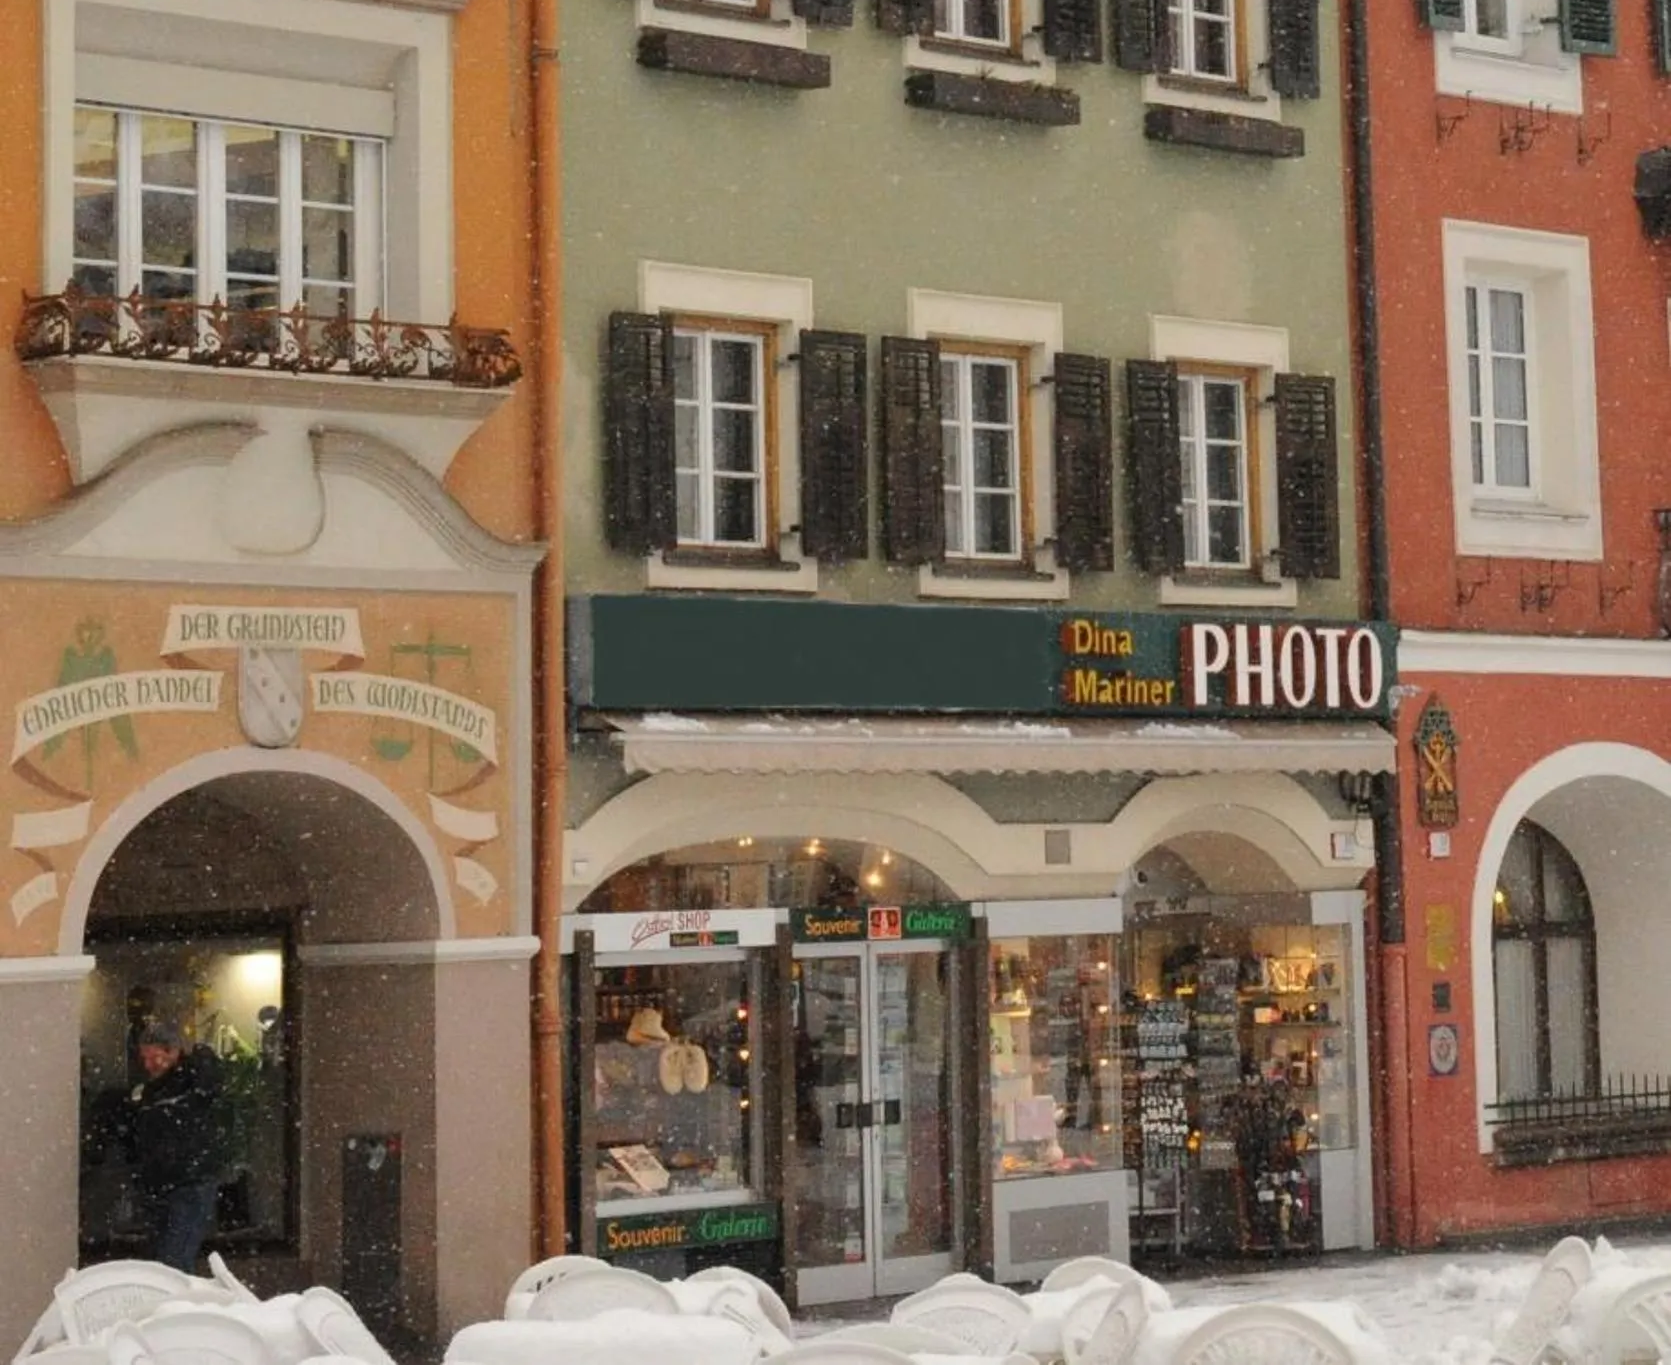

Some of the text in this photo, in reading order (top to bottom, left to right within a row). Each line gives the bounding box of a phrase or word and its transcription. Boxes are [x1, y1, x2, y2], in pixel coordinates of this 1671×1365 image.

[180, 613, 219, 641] DER
[1073, 620, 1175, 705] Dina Mariner
[1192, 623, 1383, 709] PHOTO
[319, 679, 355, 706] DES
[677, 911, 711, 931] SHOP
[805, 914, 862, 934] Souvenir
[607, 1221, 686, 1250] Souvenir
